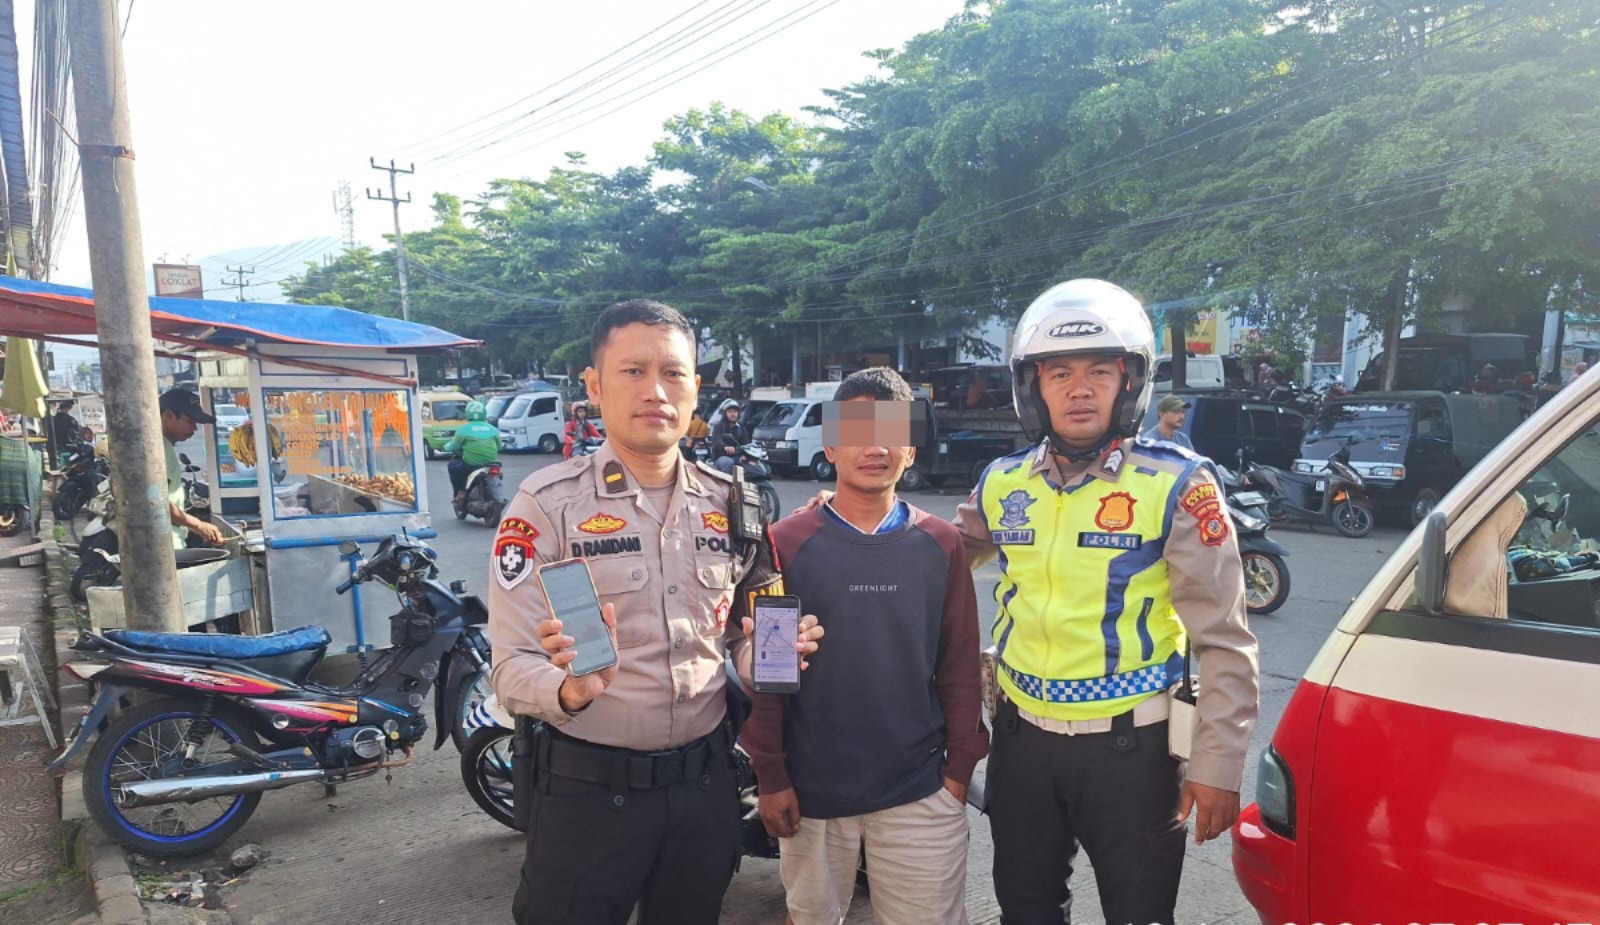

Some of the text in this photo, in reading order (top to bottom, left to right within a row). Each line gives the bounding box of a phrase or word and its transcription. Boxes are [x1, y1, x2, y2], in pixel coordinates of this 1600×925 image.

[161, 277, 197, 286] COKLAT
[1051, 323, 1098, 336] INK
[501, 519, 535, 536] SPKT
[571, 536, 642, 557] D RAMDANI
[695, 535, 738, 554] POL
[1083, 534, 1137, 548] POLRI
[848, 583, 898, 592] GREENLIGHT
